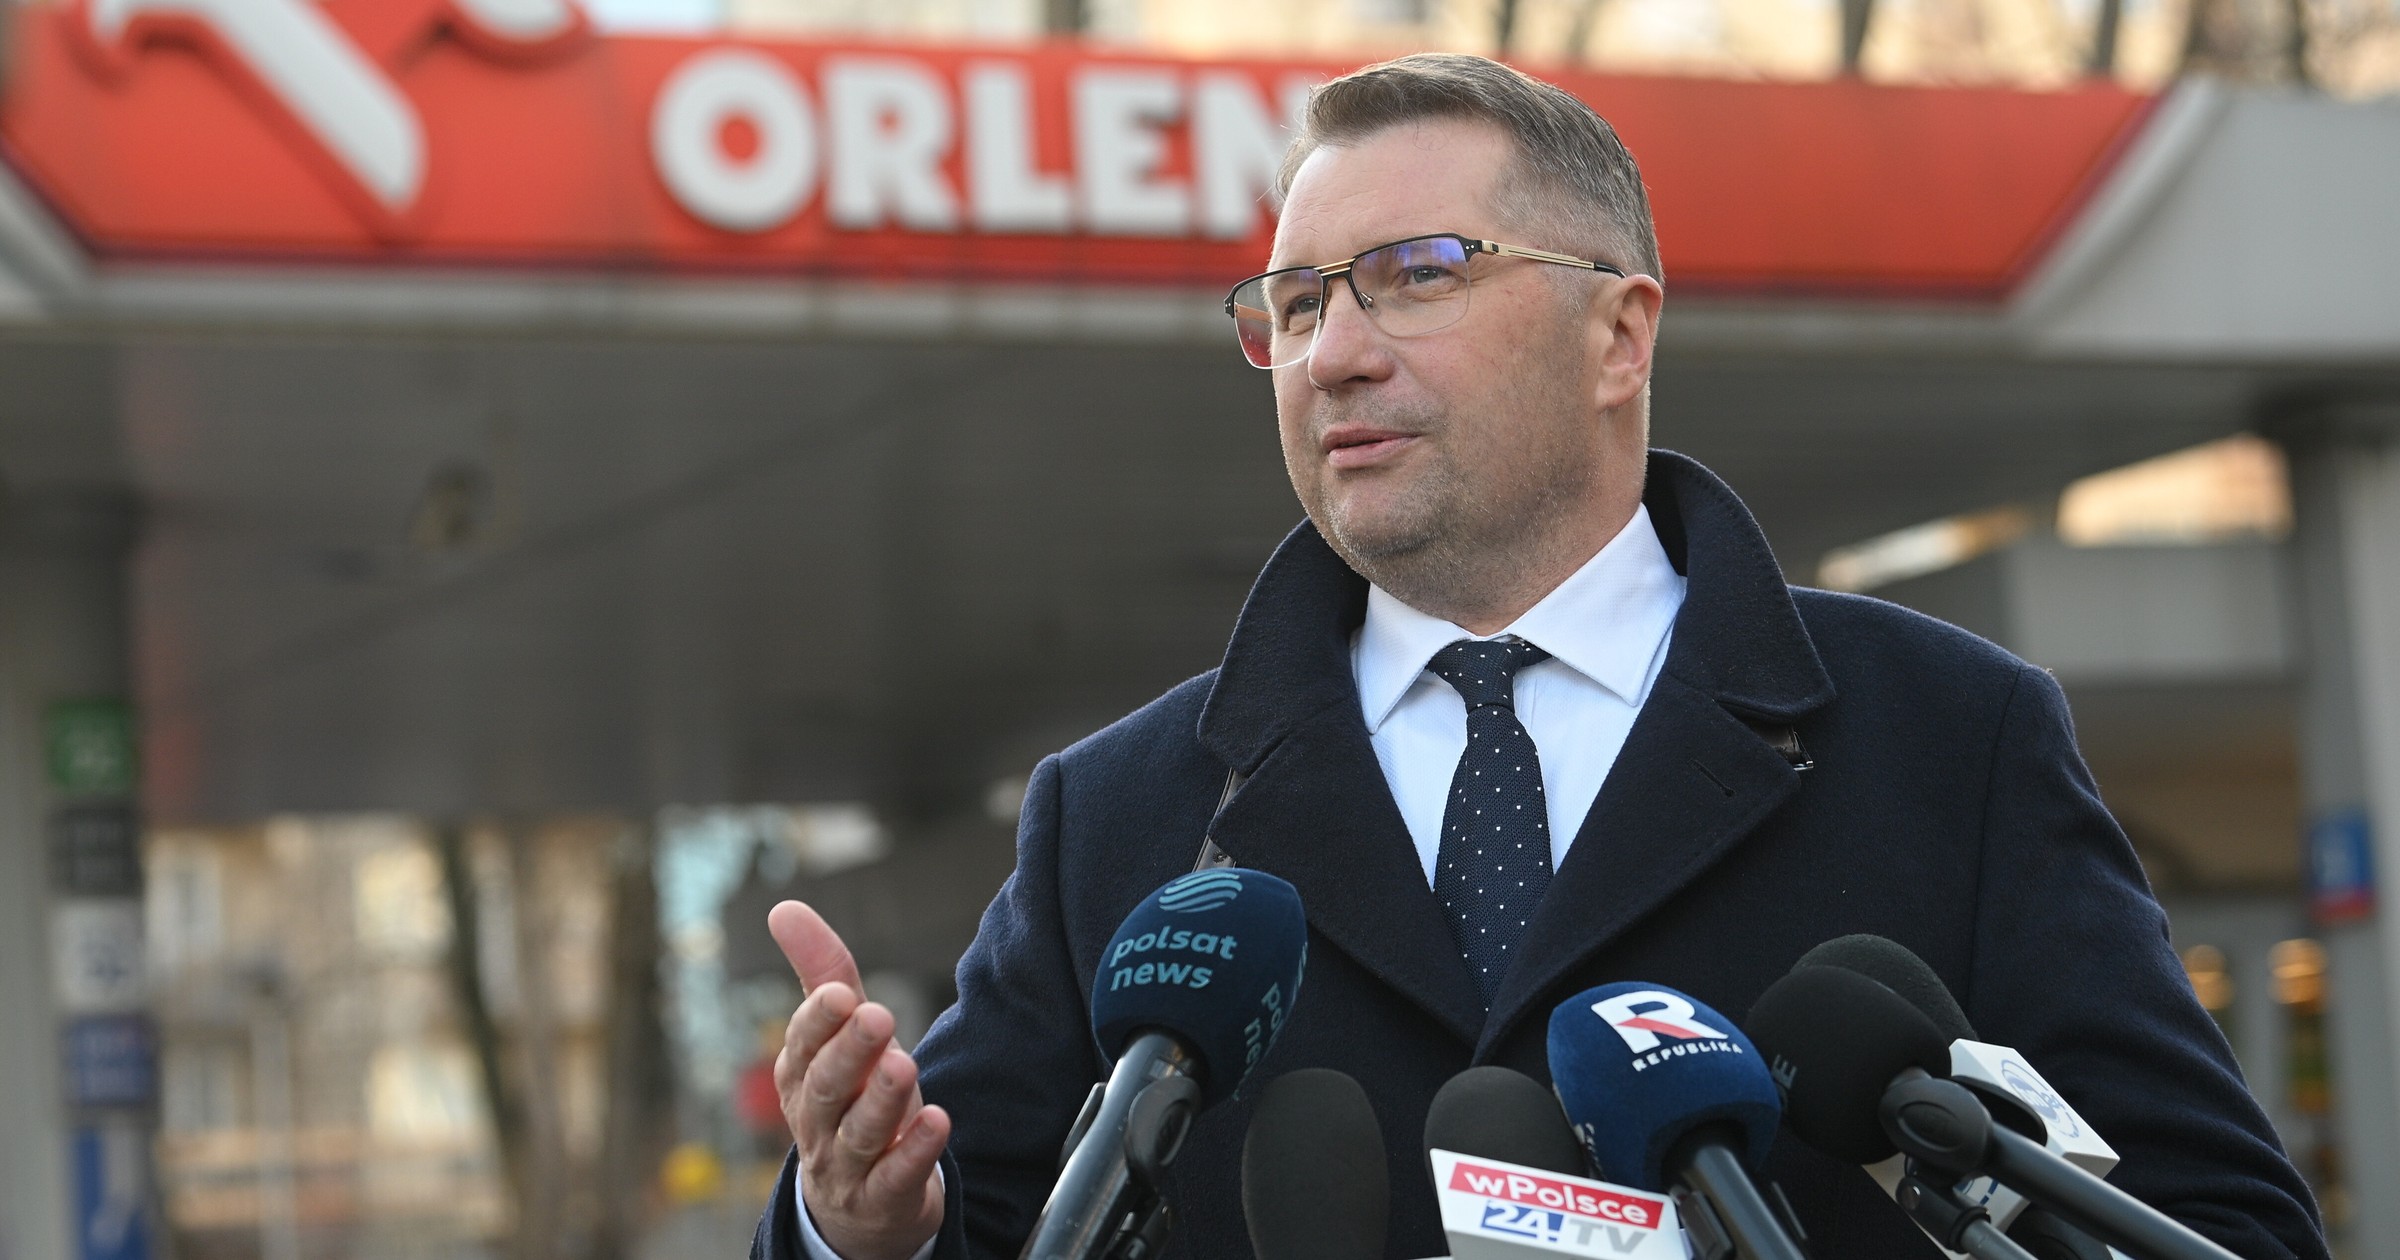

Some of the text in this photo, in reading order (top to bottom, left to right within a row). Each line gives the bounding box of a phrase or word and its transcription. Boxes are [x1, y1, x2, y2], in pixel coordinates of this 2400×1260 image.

[651, 49, 1306, 240] ORLEN
[1109, 926, 1238, 968] polsat
[1110, 962, 1213, 991] news
[1632, 1041, 1743, 1073] REPUBLIKA
[1464, 1171, 1649, 1225] wPolsce
[1569, 1218, 1647, 1255] TV
